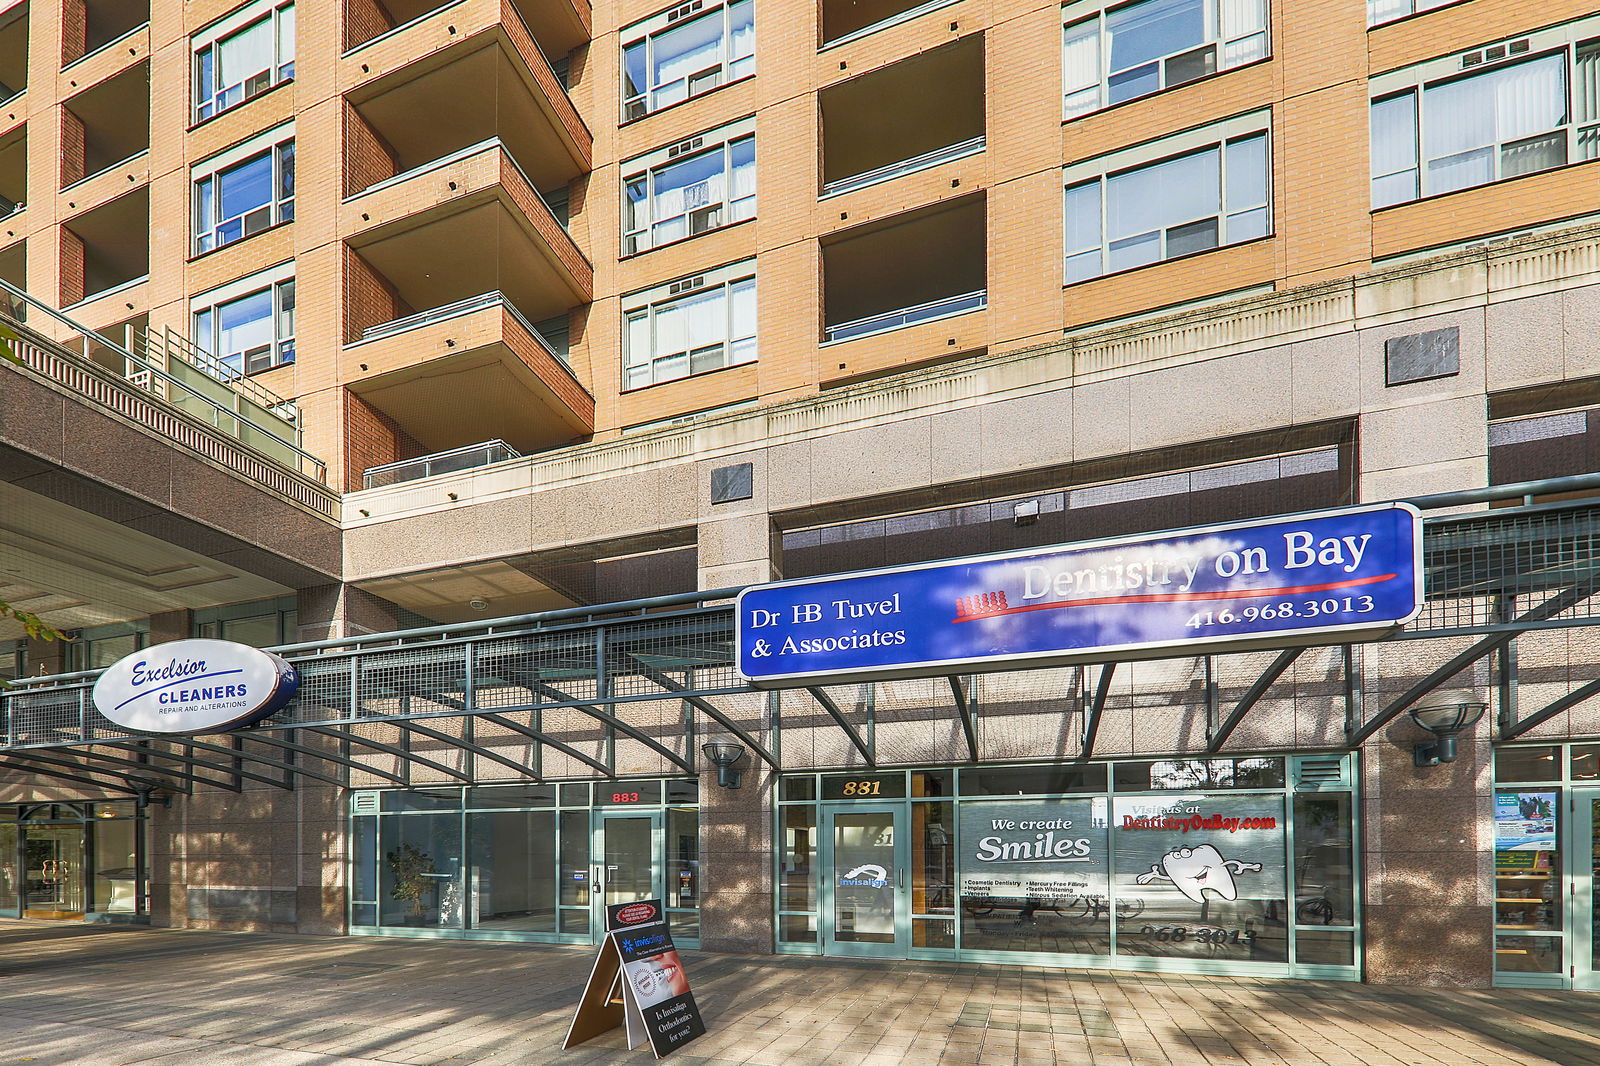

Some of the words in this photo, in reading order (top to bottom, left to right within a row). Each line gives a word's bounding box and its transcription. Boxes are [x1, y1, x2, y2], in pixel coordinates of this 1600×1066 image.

[1022, 556, 1203, 601] Dentistry
[1215, 544, 1271, 578] on
[1283, 530, 1373, 573] Bay
[750, 608, 781, 629] Dr
[792, 602, 823, 624] HB
[832, 592, 901, 621] Tuvel
[1184, 594, 1375, 630] 416.968.3013
[750, 638, 773, 658] &
[778, 628, 907, 656] Associates
[130, 657, 208, 687] Excelsior
[158, 683, 248, 705] CLEANERS
[158, 706, 183, 715] REPAIR
[184, 705, 199, 713] AND
[199, 700, 248, 711] ALTERATIONS
[611, 792, 639, 803] 883
[842, 780, 881, 796] 881
[1131, 804, 1162, 815] Visit
[1166, 805, 1182, 815] us
[1185, 804, 1201, 815] at
[991, 819, 1016, 831] We
[1019, 817, 1073, 831] create
[1122, 813, 1277, 833] DentistryOnBay.com
[976, 831, 1092, 862] Smiles
[839, 877, 889, 888] invisalign
[994, 880, 1022, 888] Dentistry
[1044, 886, 1074, 894] Whitening
[655, 1011, 663, 1021] Is
[662, 1001, 688, 1018] Invisalign
[658, 1012, 693, 1034] Orthodontics
[669, 1033, 678, 1043] for
[677, 1025, 691, 1041] you?
